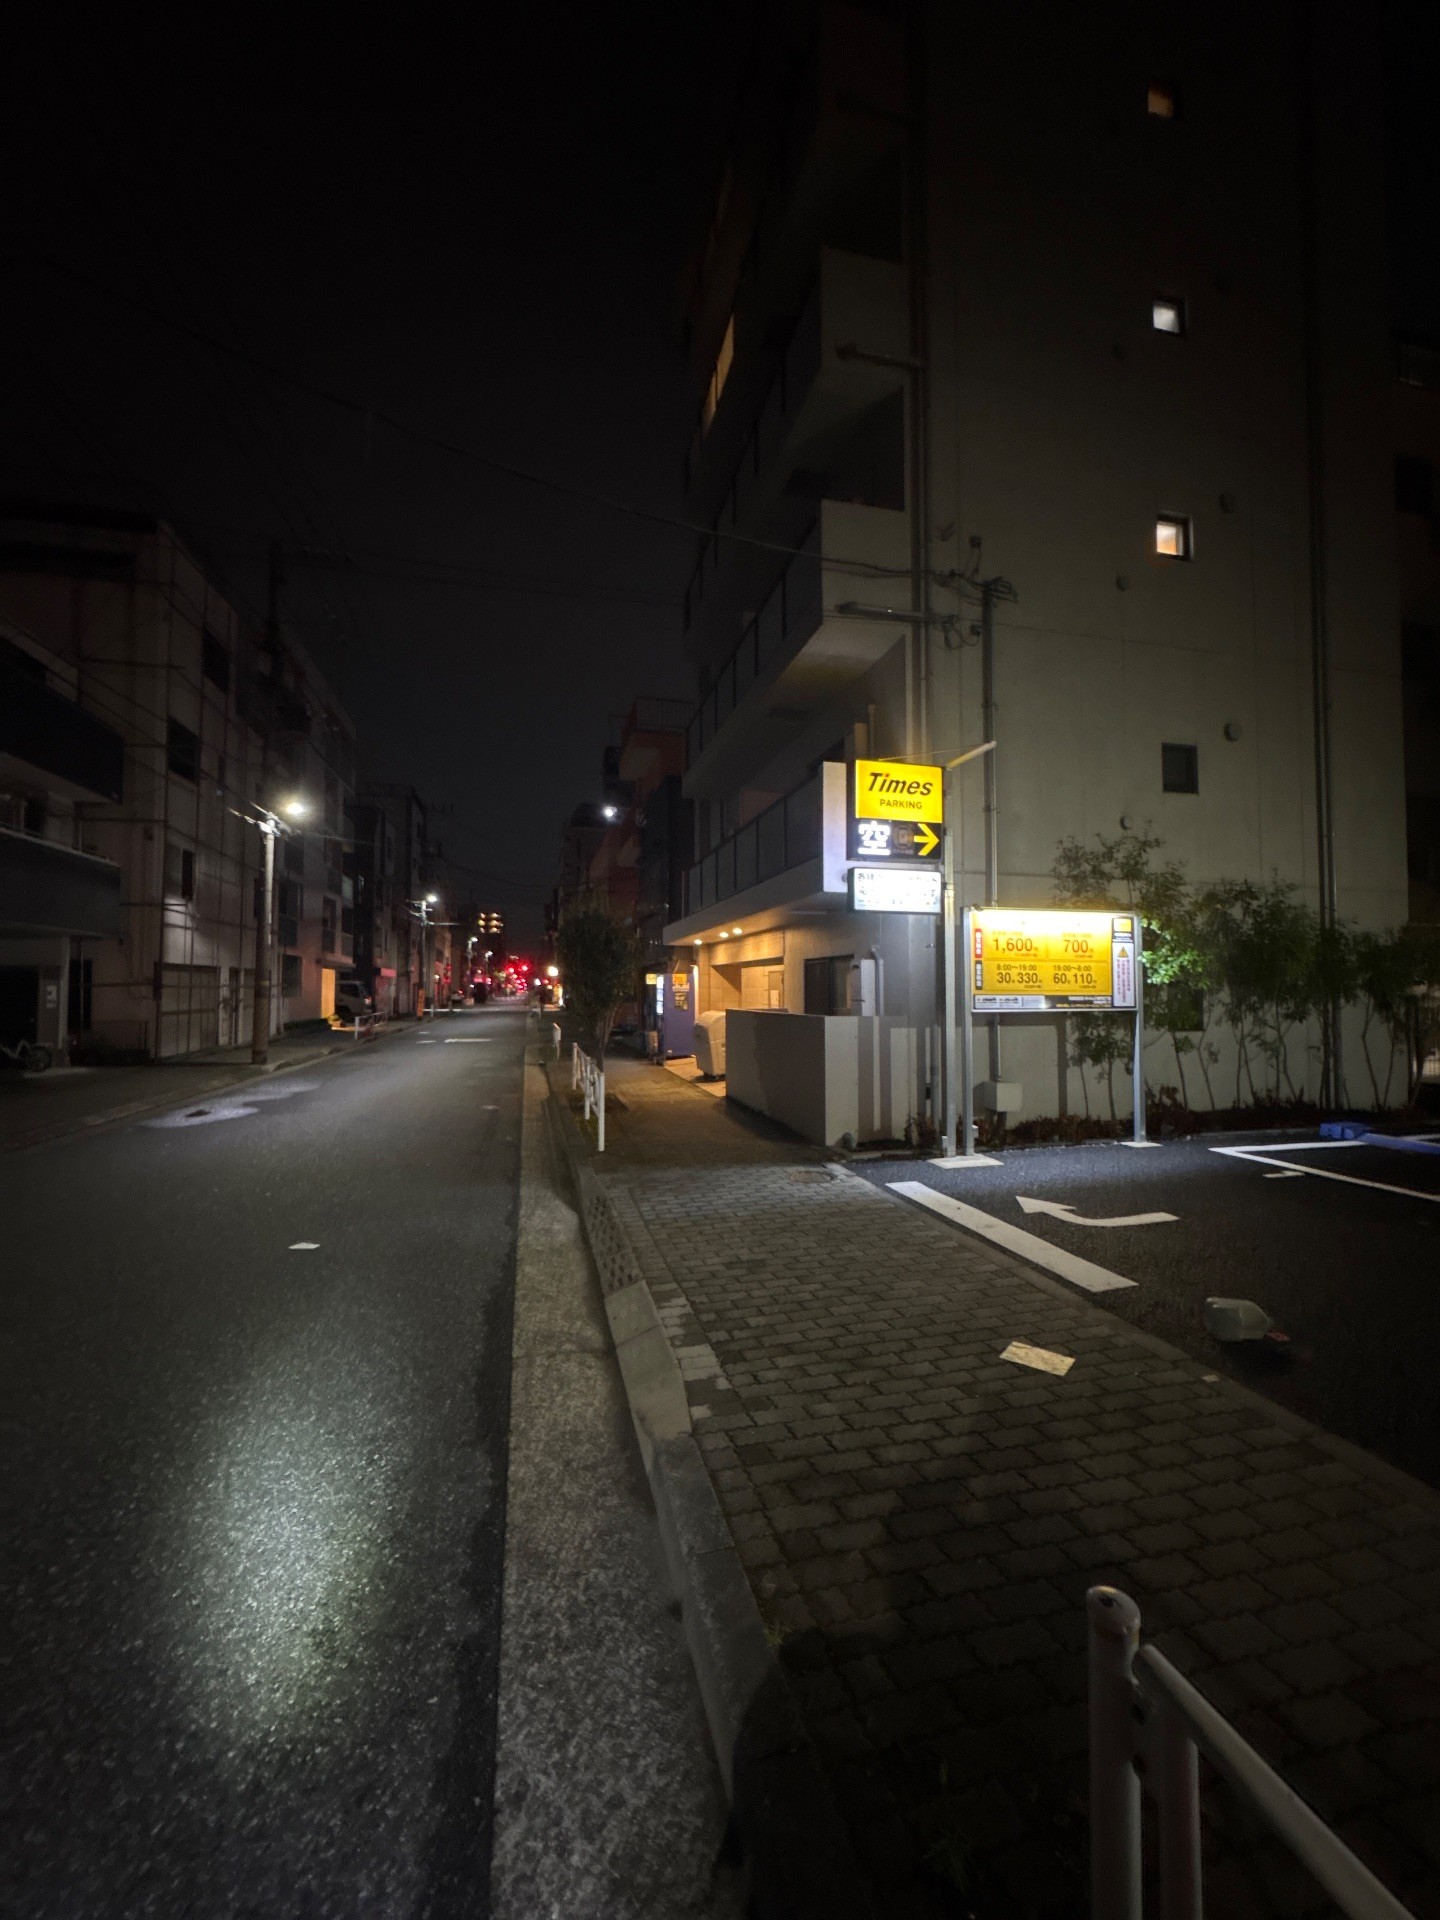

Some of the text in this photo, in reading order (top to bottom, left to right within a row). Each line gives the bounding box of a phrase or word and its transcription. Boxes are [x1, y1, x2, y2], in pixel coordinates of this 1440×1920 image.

[867, 772, 934, 796] Times
[879, 798, 923, 810] PARKING
[858, 820, 892, 856] 空
